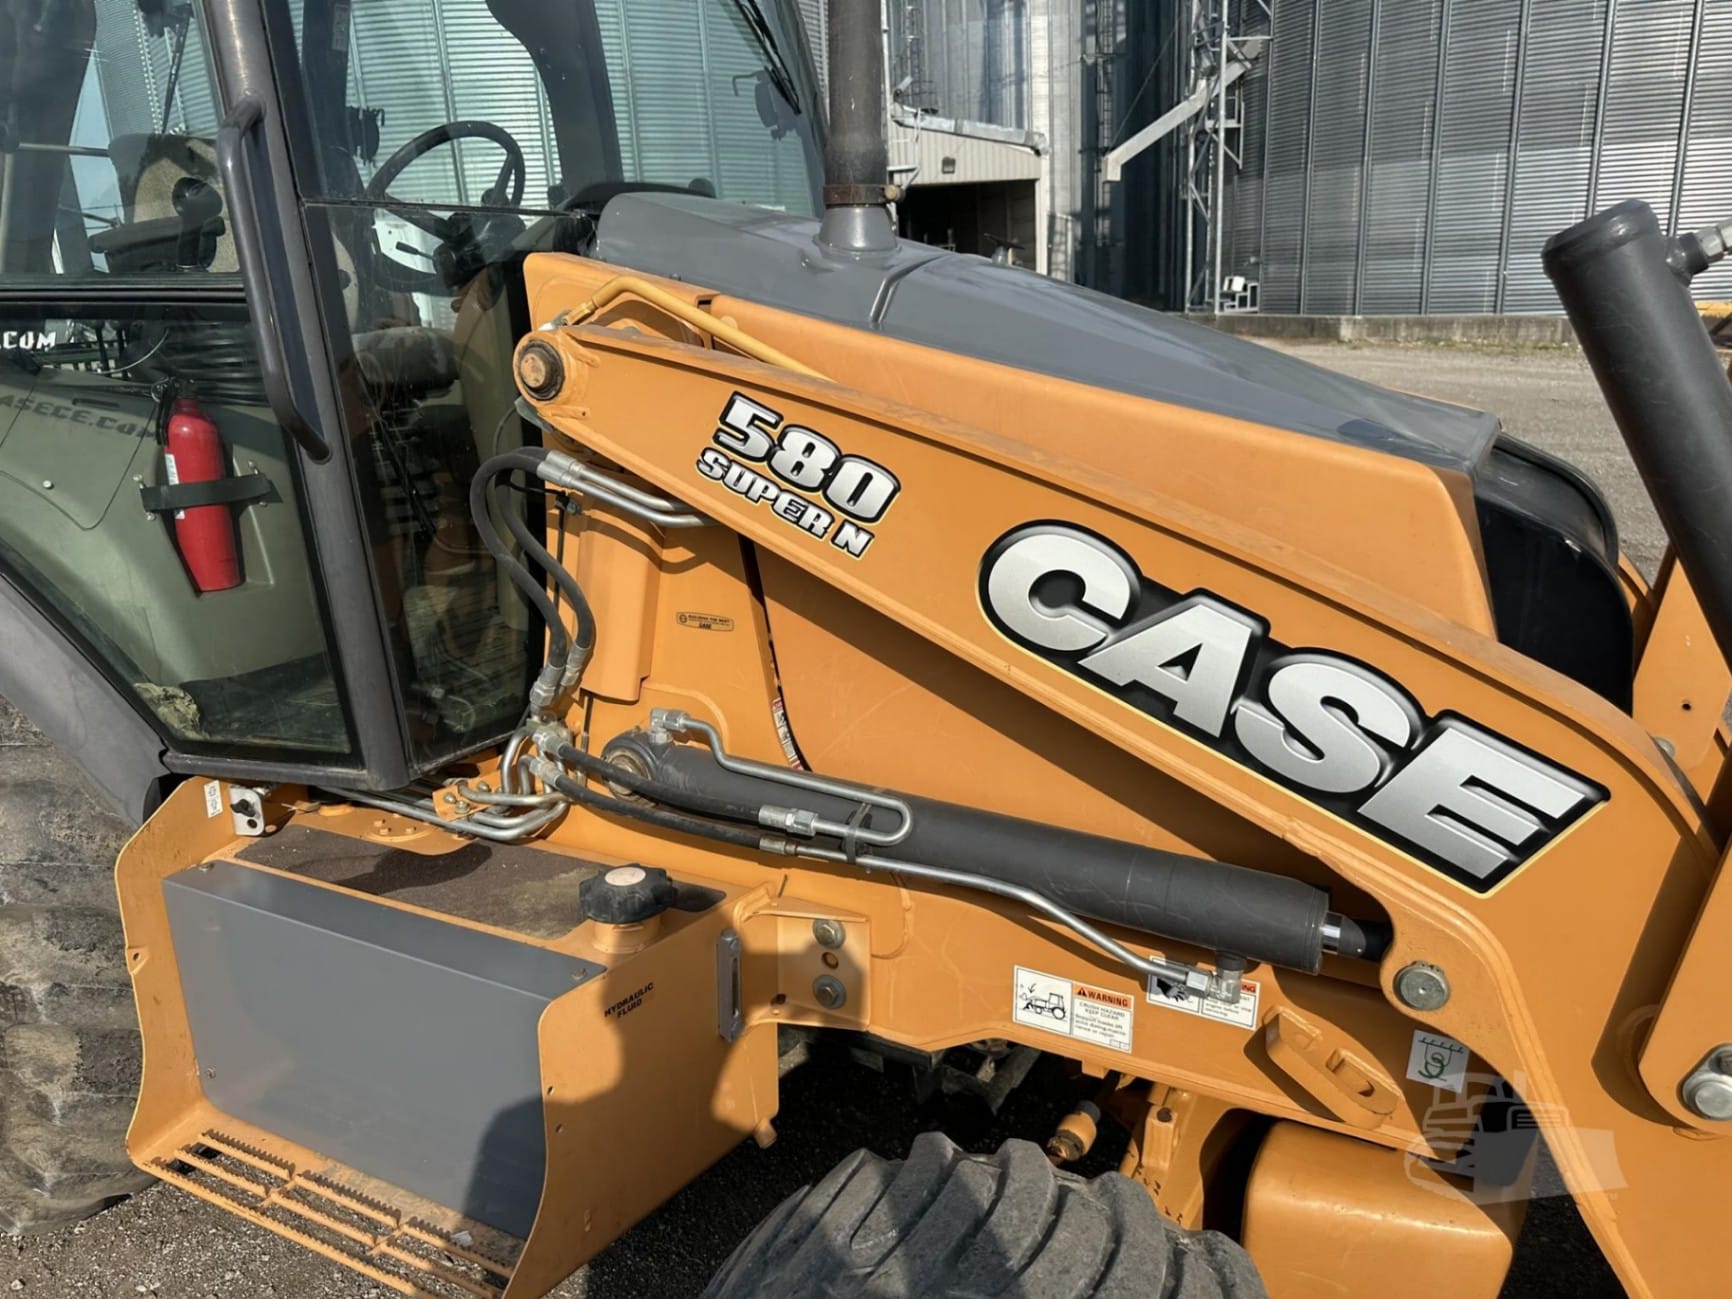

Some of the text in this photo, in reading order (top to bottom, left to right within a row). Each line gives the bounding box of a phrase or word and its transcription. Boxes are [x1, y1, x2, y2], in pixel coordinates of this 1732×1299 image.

[713, 391, 901, 523] 580
[697, 447, 875, 558] SUPER N
[978, 519, 1612, 896] CASE
[604, 982, 654, 1017] HYDRAULIC
[617, 998, 642, 1018] FLUID
[1087, 990, 1128, 1007] WARNING
